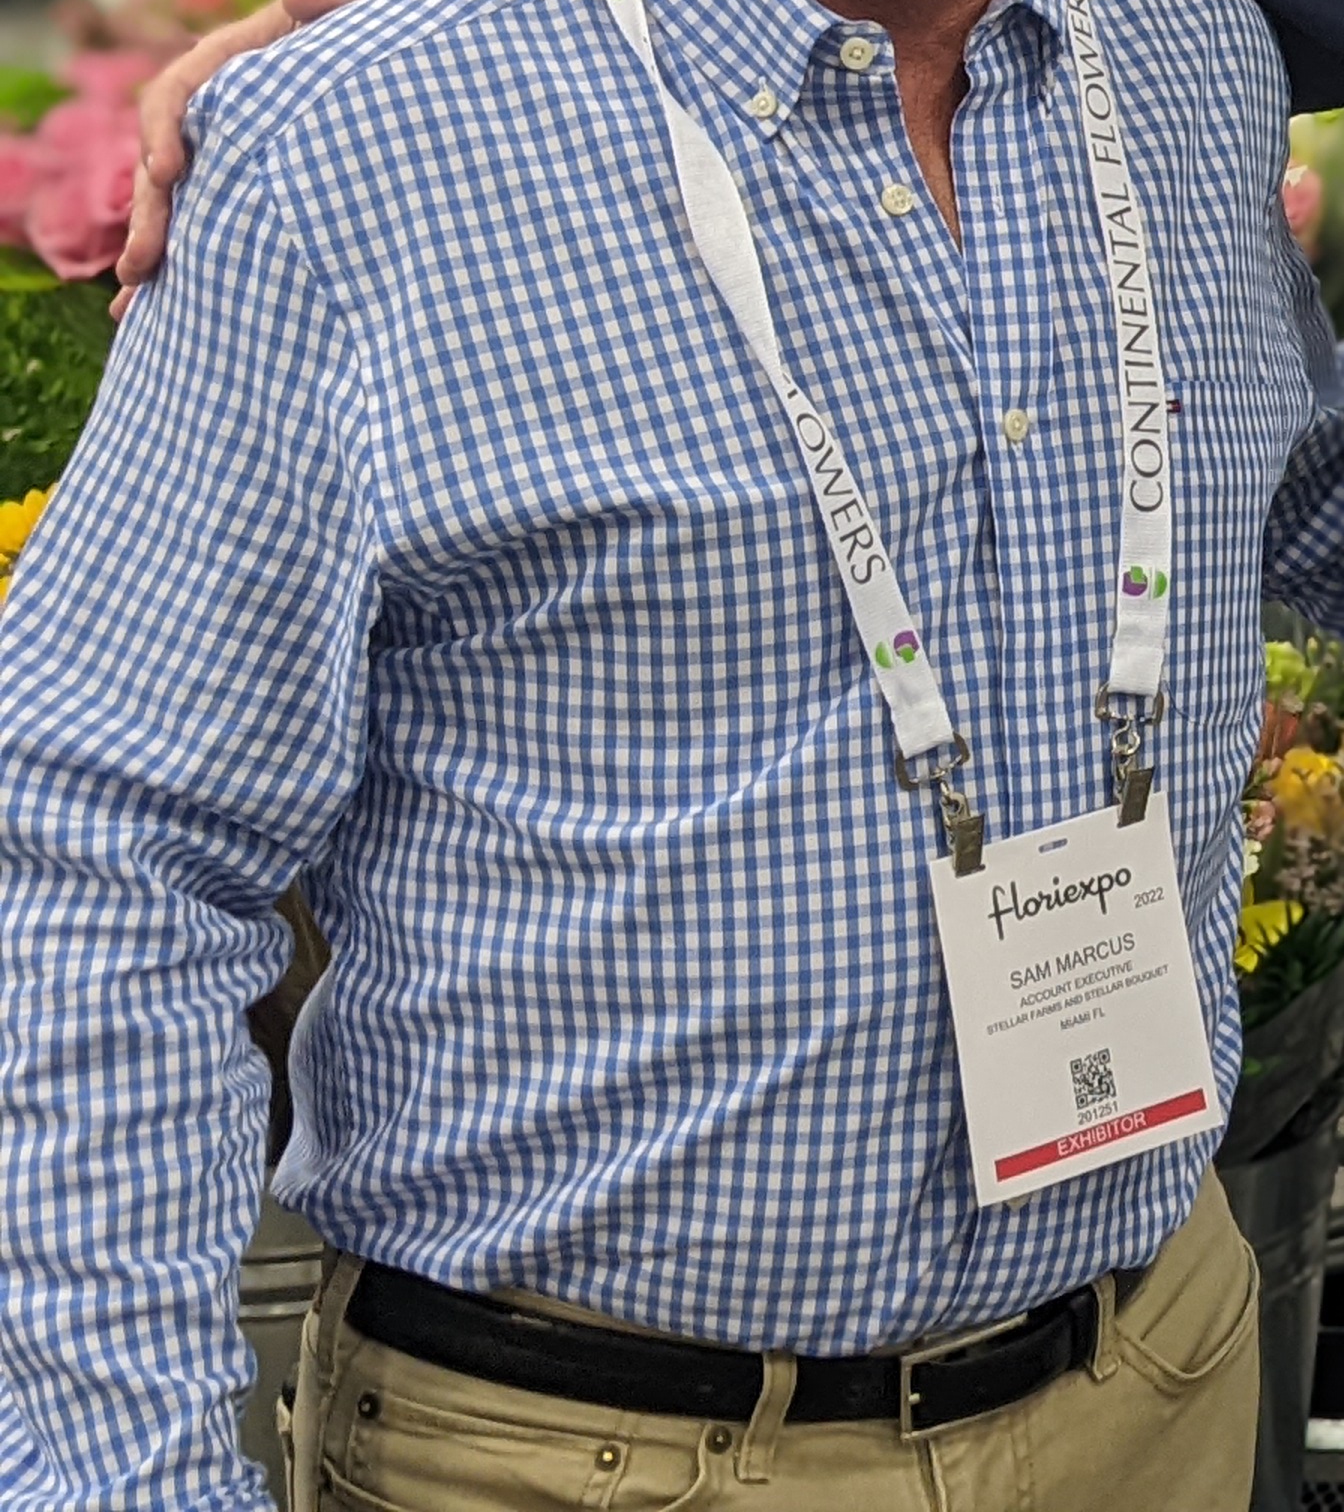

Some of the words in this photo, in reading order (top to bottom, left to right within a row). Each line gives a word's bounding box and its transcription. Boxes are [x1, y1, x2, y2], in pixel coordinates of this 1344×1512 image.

[1101, 182, 1166, 514] CONTINENTAL
[783, 372, 887, 585] OWERS
[988, 866, 1132, 940] floriexpo
[1133, 887, 1165, 909] 2022
[1010, 959, 1053, 990] SAM
[1055, 932, 1136, 973] MARCUS
[1019, 982, 1072, 1009] ACCOUNT
[1074, 960, 1134, 994] EXECUTIVE
[986, 1012, 1028, 1036] STELLAR
[1030, 1002, 1062, 1023] FARMS
[1064, 996, 1083, 1012] AND
[1084, 981, 1124, 1006] STELLAR
[1125, 963, 1169, 991] BOUQUET
[1059, 1013, 1091, 1030] MIAMI
[1092, 1008, 1106, 1022] FL
[1056, 1111, 1148, 1156] EXHIBITOR
[1077, 1101, 1119, 1125] 201251
